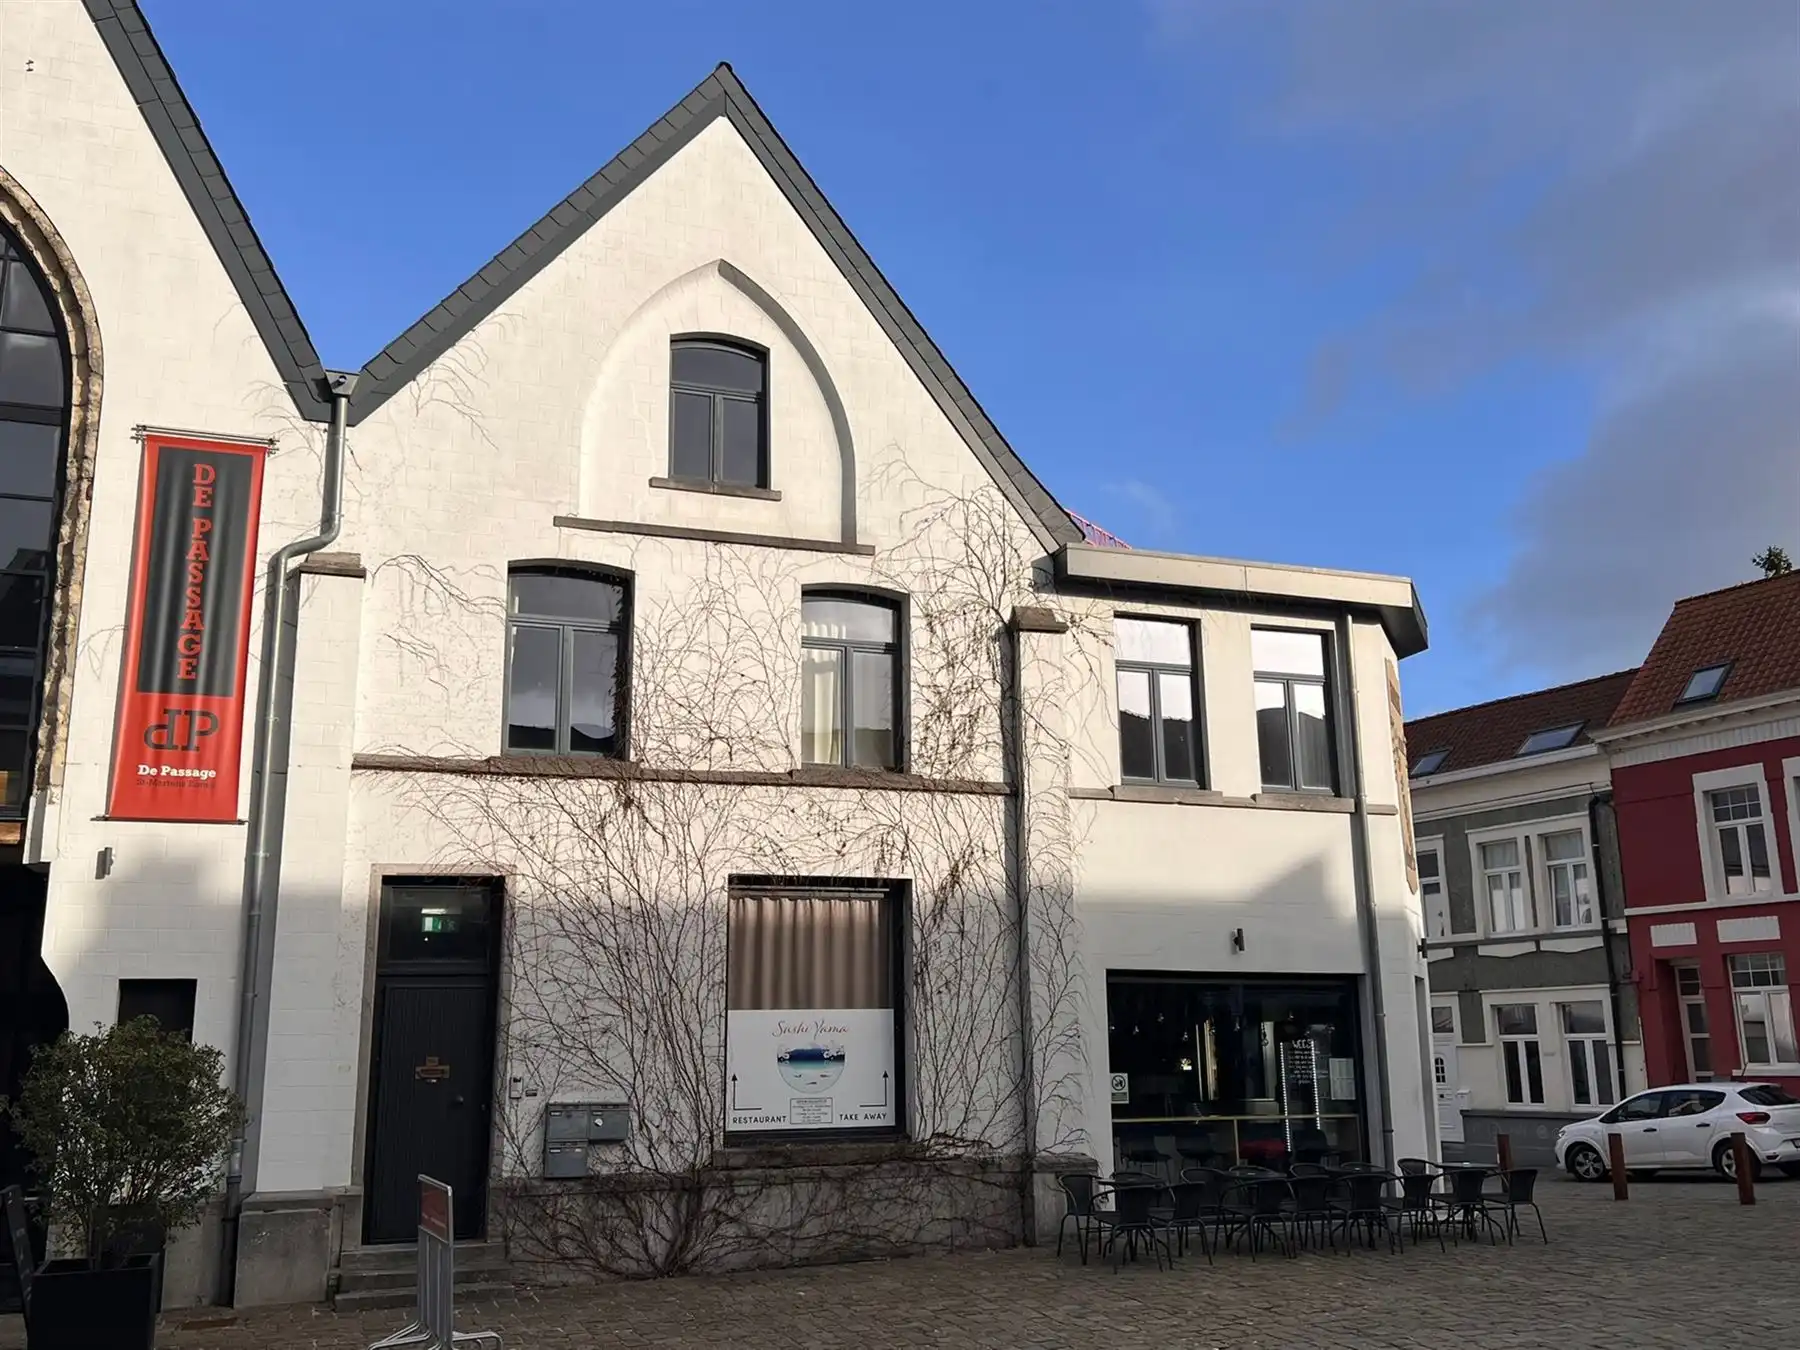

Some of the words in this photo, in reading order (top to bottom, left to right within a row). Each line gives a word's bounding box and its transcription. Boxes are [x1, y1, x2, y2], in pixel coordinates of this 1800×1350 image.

[192, 463, 215, 508] DE
[176, 517, 212, 680] PASSAGE
[137, 764, 158, 776] De
[160, 765, 217, 780] Passage
[772, 1019, 809, 1037] Sushi
[813, 1018, 849, 1040] Yama
[732, 1115, 787, 1124] RESTAURANT
[839, 1113, 859, 1121] TAKE
[864, 1112, 887, 1121] AWAY
